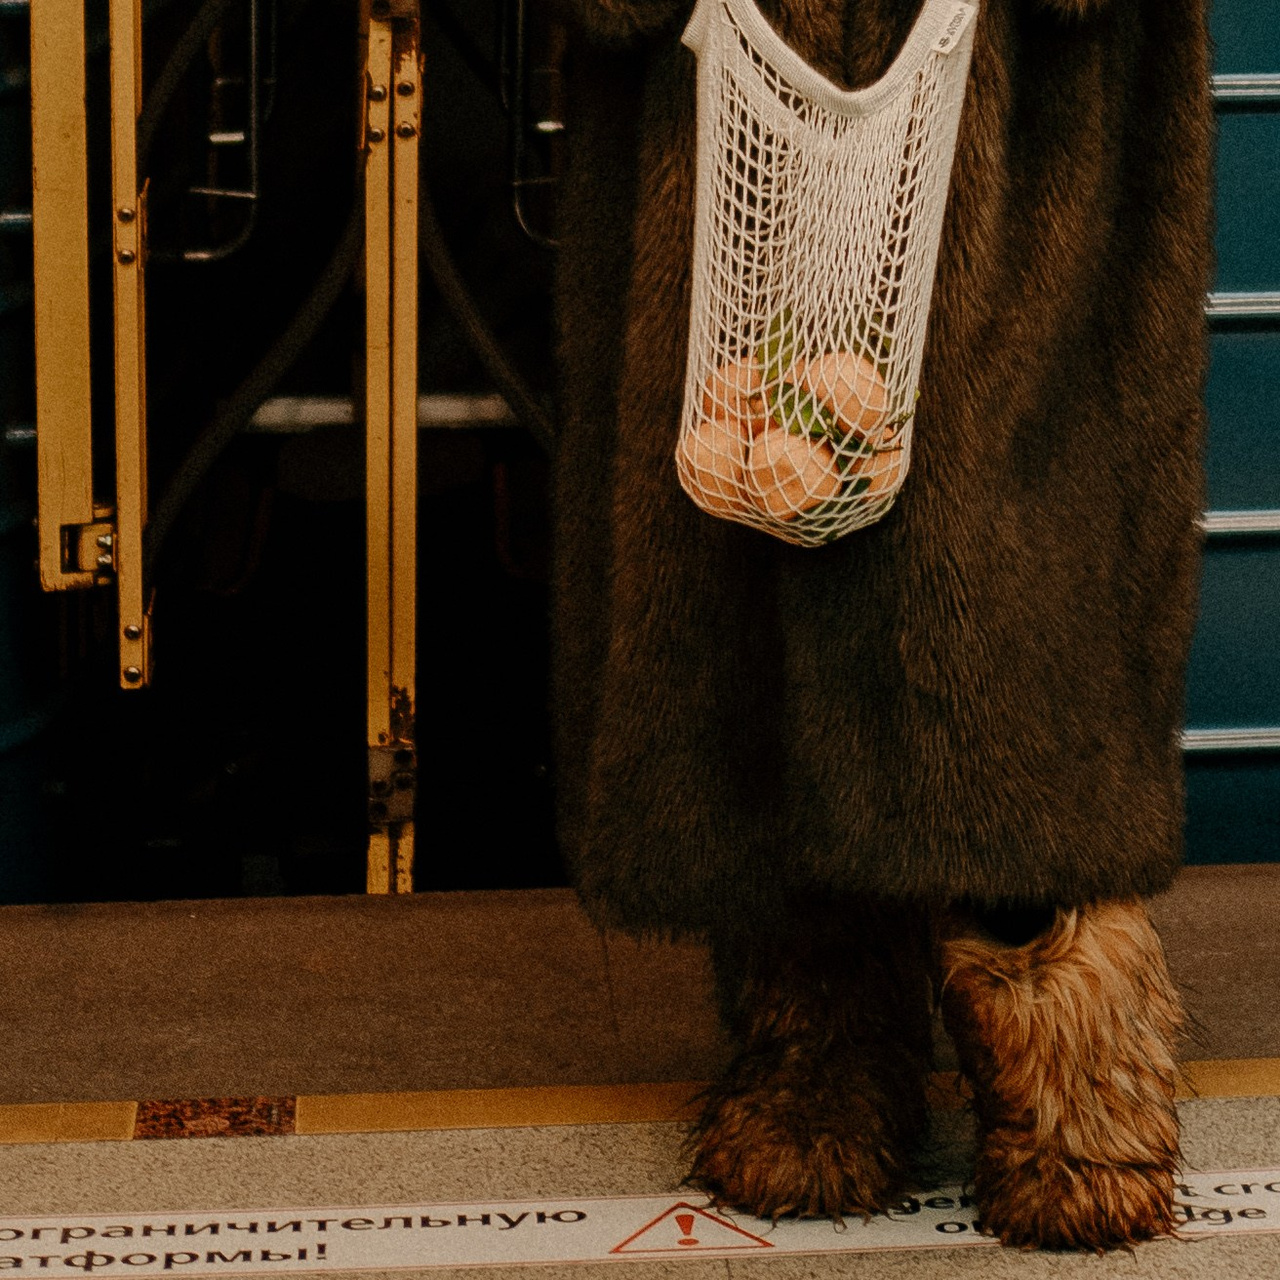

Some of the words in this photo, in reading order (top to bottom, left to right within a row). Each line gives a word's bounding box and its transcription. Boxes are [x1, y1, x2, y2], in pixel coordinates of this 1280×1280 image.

[0, 1209, 588, 1244] ограничительную
[1172, 1203, 1267, 1226] dge
[0, 1243, 327, 1272] атформы!
